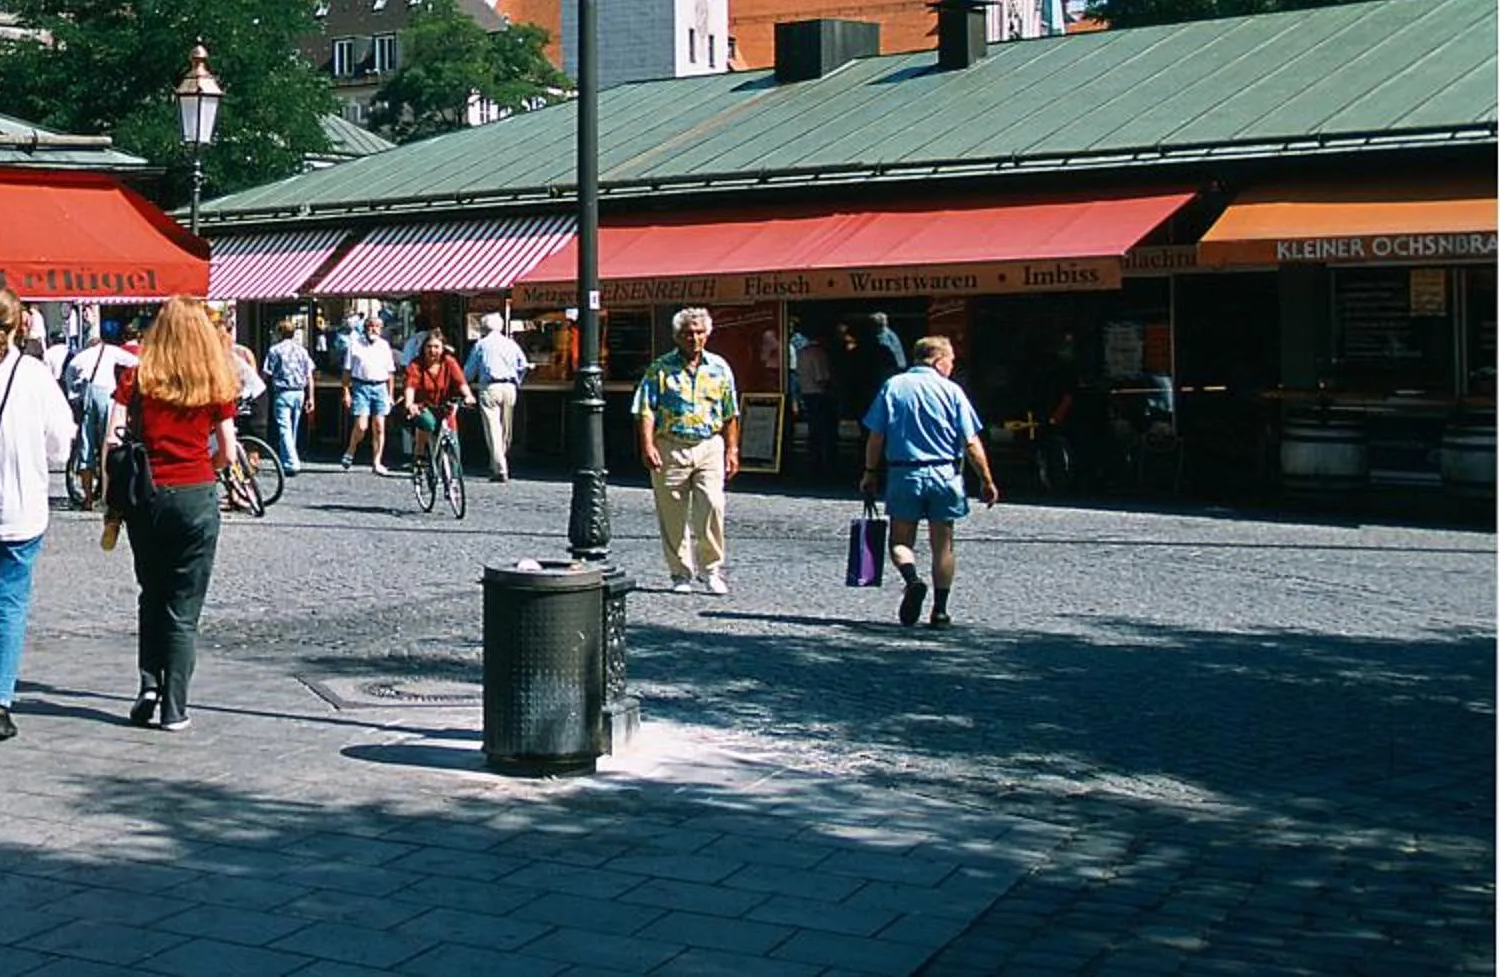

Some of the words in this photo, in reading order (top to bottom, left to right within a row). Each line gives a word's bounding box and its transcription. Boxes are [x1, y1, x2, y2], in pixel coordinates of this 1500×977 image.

[1277, 237, 1365, 260] KLEINER
[1372, 232, 1498, 256] OCHSNBRA
[523, 285, 579, 306] Metzge
[601, 278, 717, 302] EISENREICH
[742, 274, 810, 296] Fleisch
[847, 271, 978, 293] Wurstwaren
[1022, 263, 1100, 287] Imbiss
